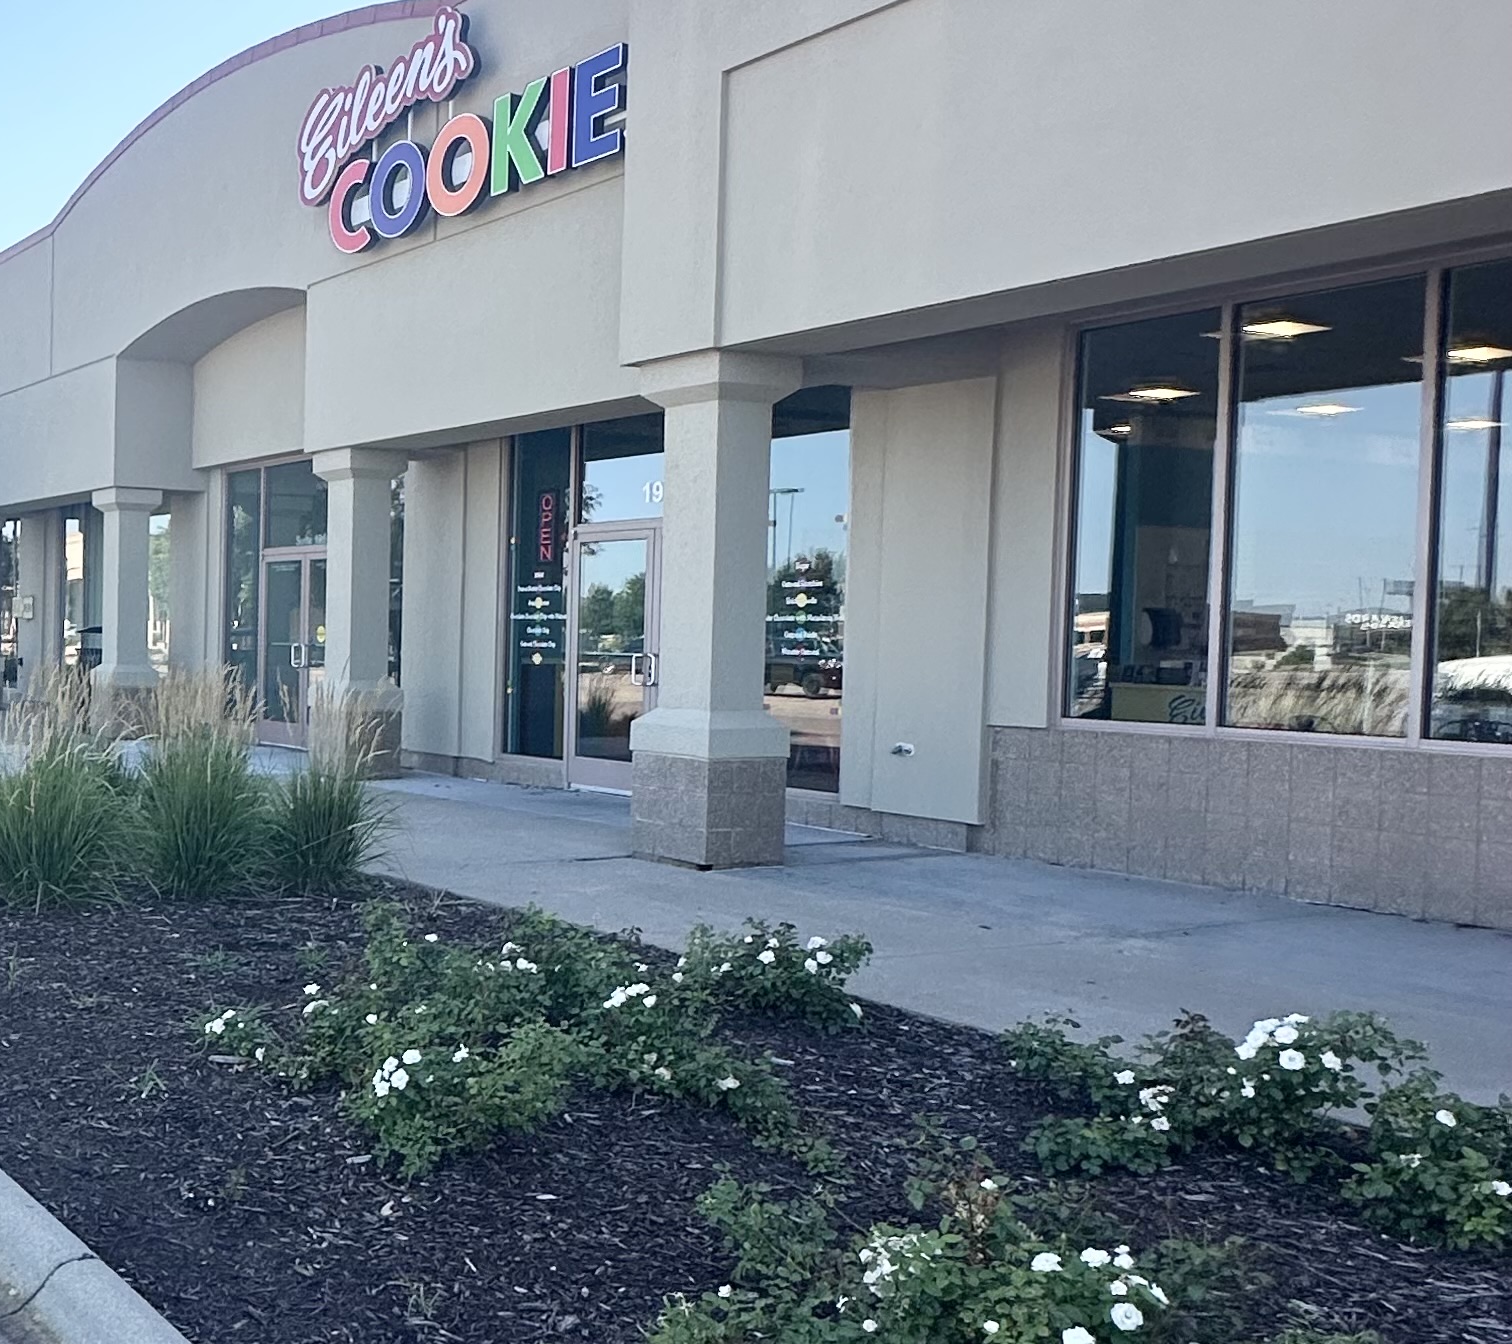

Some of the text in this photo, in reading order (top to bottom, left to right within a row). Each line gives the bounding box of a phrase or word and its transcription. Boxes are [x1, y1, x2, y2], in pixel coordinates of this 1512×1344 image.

[298, 7, 472, 205] Eileen's
[329, 42, 627, 253] COOKIE
[540, 494, 554, 562] OPEN
